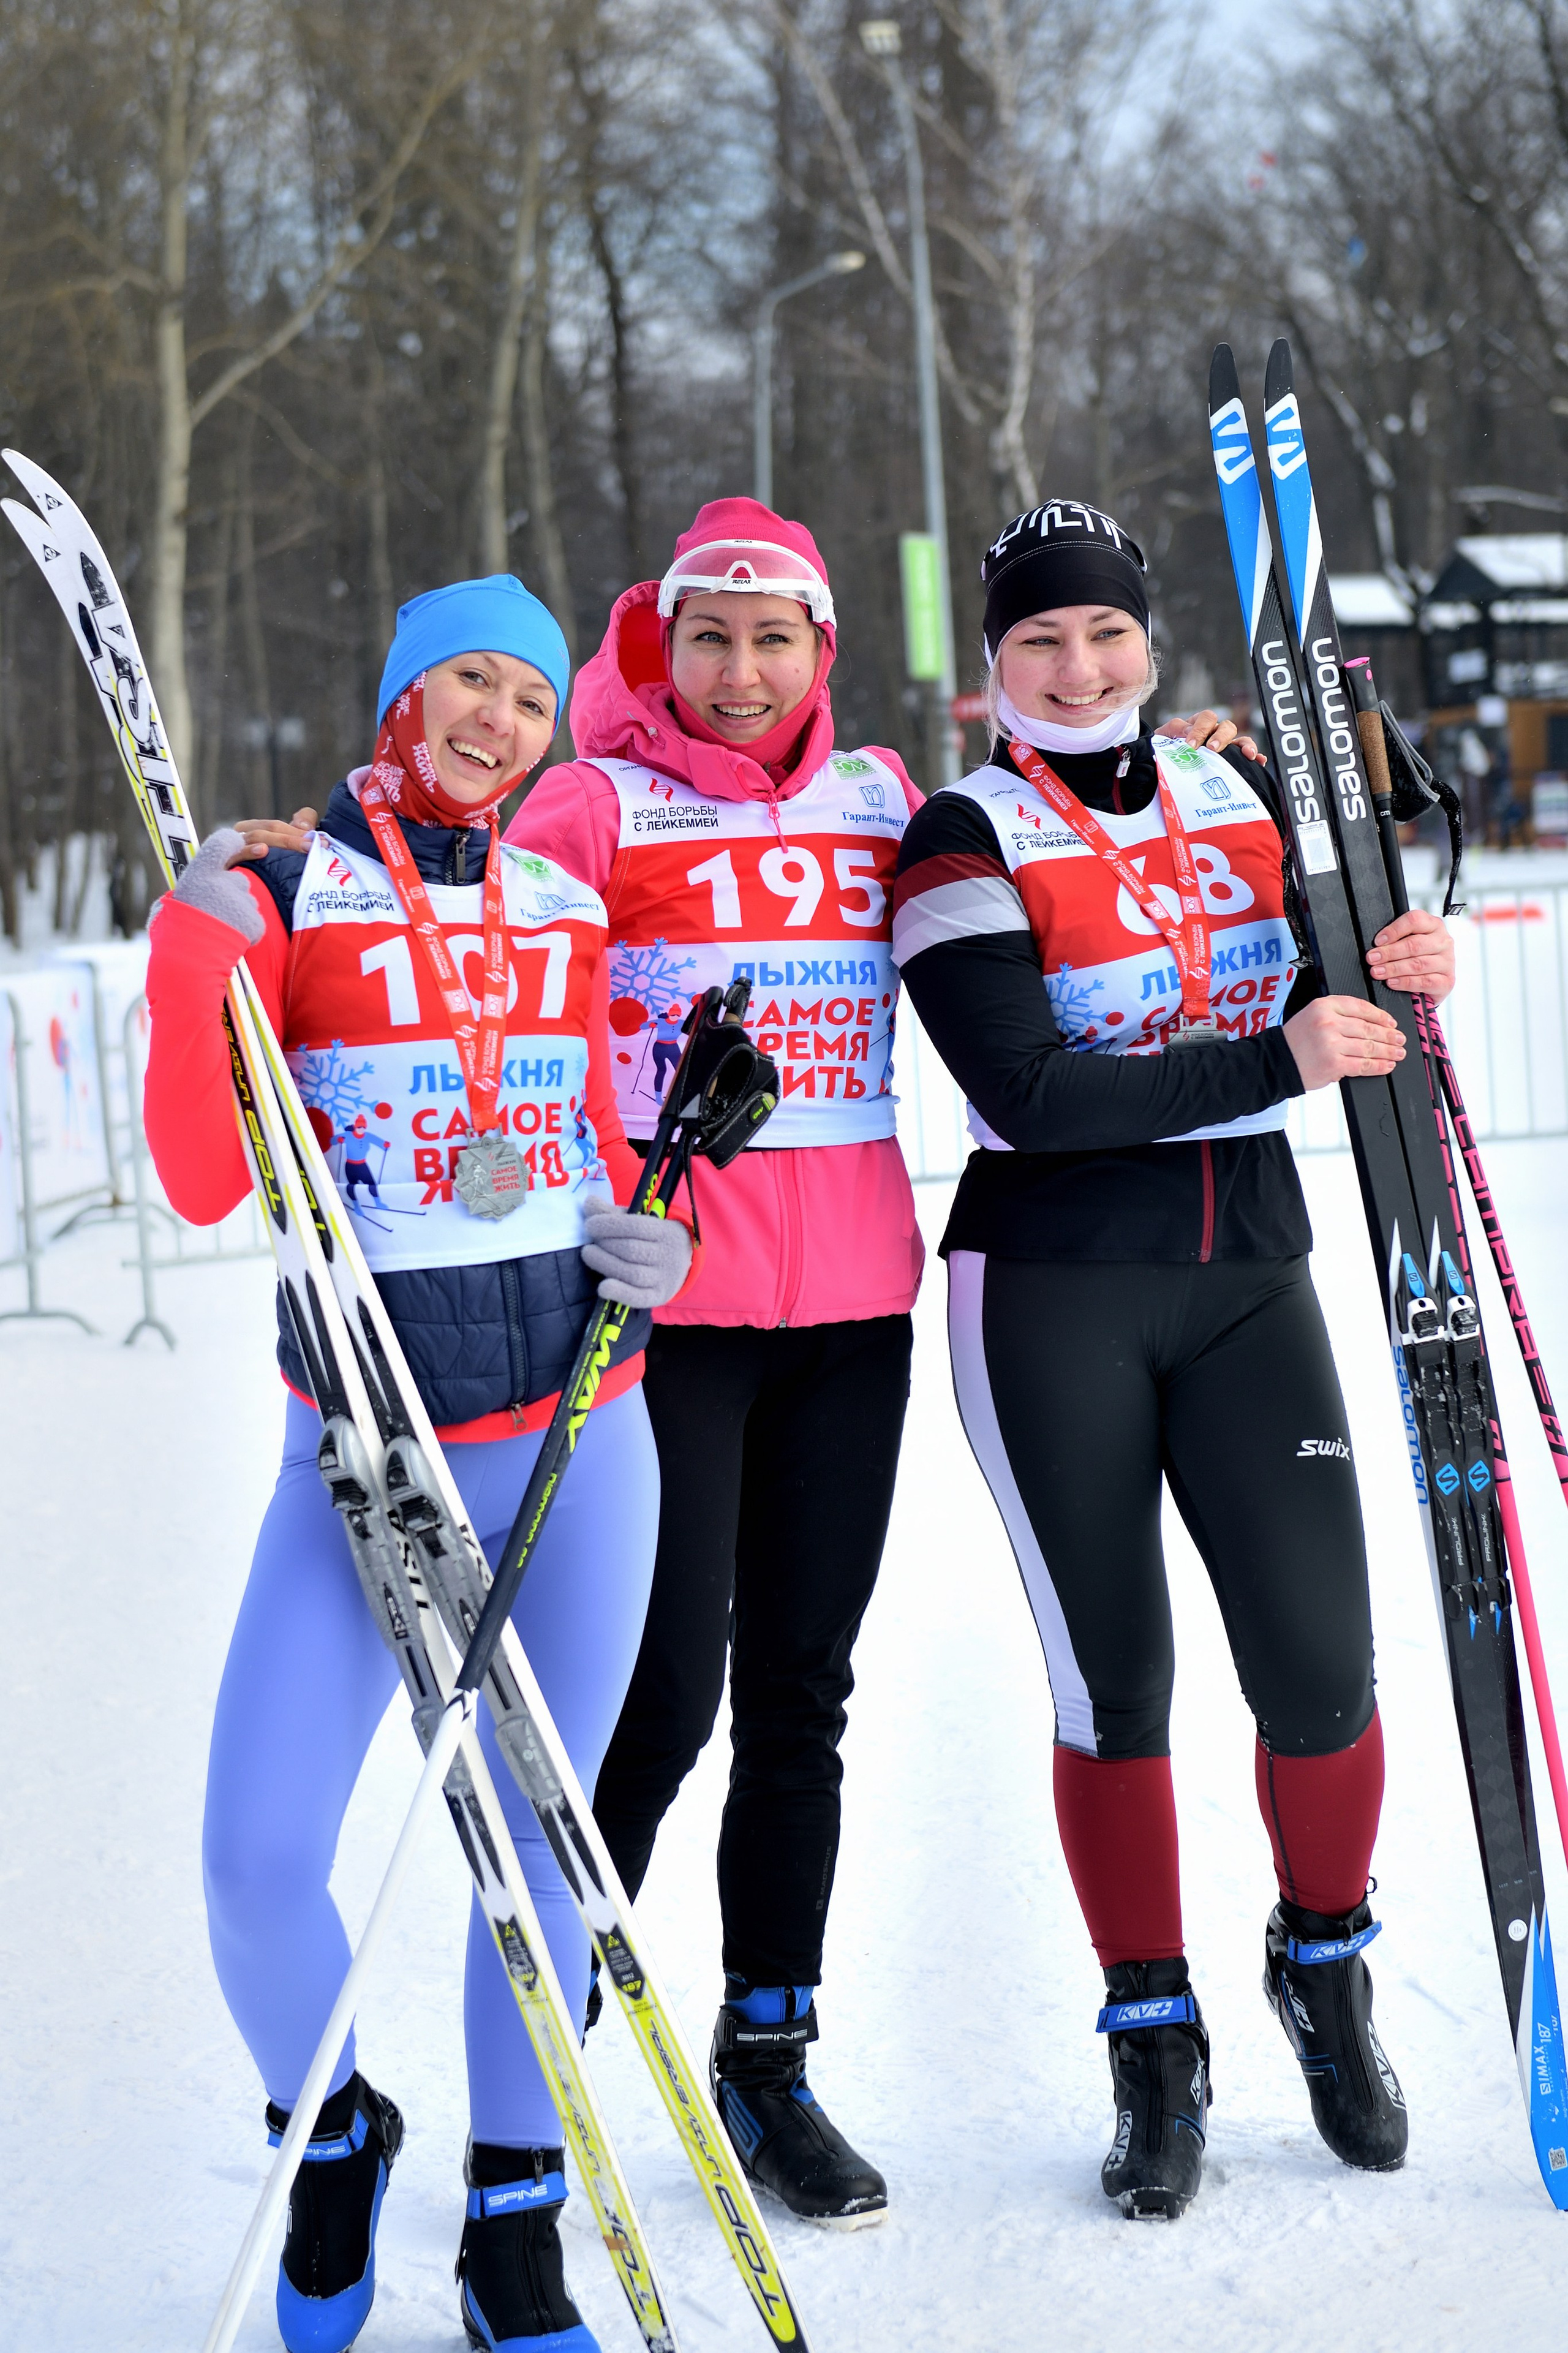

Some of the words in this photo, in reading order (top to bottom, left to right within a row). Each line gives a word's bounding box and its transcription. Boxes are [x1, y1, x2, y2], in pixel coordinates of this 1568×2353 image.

[1261, 640, 1320, 823] salomon
[1311, 636, 1366, 821] salomon
[381, 782, 401, 802] ИТЬ
[1042, 783, 1069, 811] ЛЕЙКЕМИЕЙ
[1054, 785, 1074, 808] БОРЬБЫ
[632, 807, 666, 819] ФОНД
[668, 806, 717, 817] БОРЬБЫ
[634, 822, 642, 831] С
[647, 815, 719, 831] ЛЕЙКЕМИЕЙ
[842, 811, 905, 828] Гарант-Инвест
[1016, 842, 1026, 850] С
[1030, 838, 1088, 848] ЛЕЙКЕМИЕ
[687, 846, 887, 928] 195
[1117, 843, 1255, 936] 68
[317, 901, 395, 912] ЛЕЙКЕМИЕЙ
[728, 960, 877, 989] ЛЫЖНЯ
[1177, 946, 1189, 980] ЛЕЙКЕМИ
[360, 931, 571, 1027] 107
[1127, 1007, 1271, 1048] РМЯ
[745, 1030, 869, 1062] РЕМЯ
[777, 1065, 867, 1099] ИТЬ
[245, 1109, 281, 1213] TOP
[491, 1166, 518, 1176] САМОЕ
[492, 1174, 519, 1184] ВРЕМЯ
[494, 1182, 521, 1193] ЖИТЬ
[1453, 1113, 1539, 1361] CAMPRA
[1392, 1345, 1429, 1505] salomon
[519, 1973, 535, 1982] 87
[622, 1980, 642, 1992] 187
[1117, 2001, 1173, 2022] KV+
[736, 2028, 809, 2042] SPINE
[1537, 2022, 1551, 2043] 187
[648, 2018, 723, 2177] UNIVERSAL
[1104, 2110, 1132, 2172] KV+
[488, 2183, 548, 2207] SPINE
[717, 2185, 783, 2317] TOP
